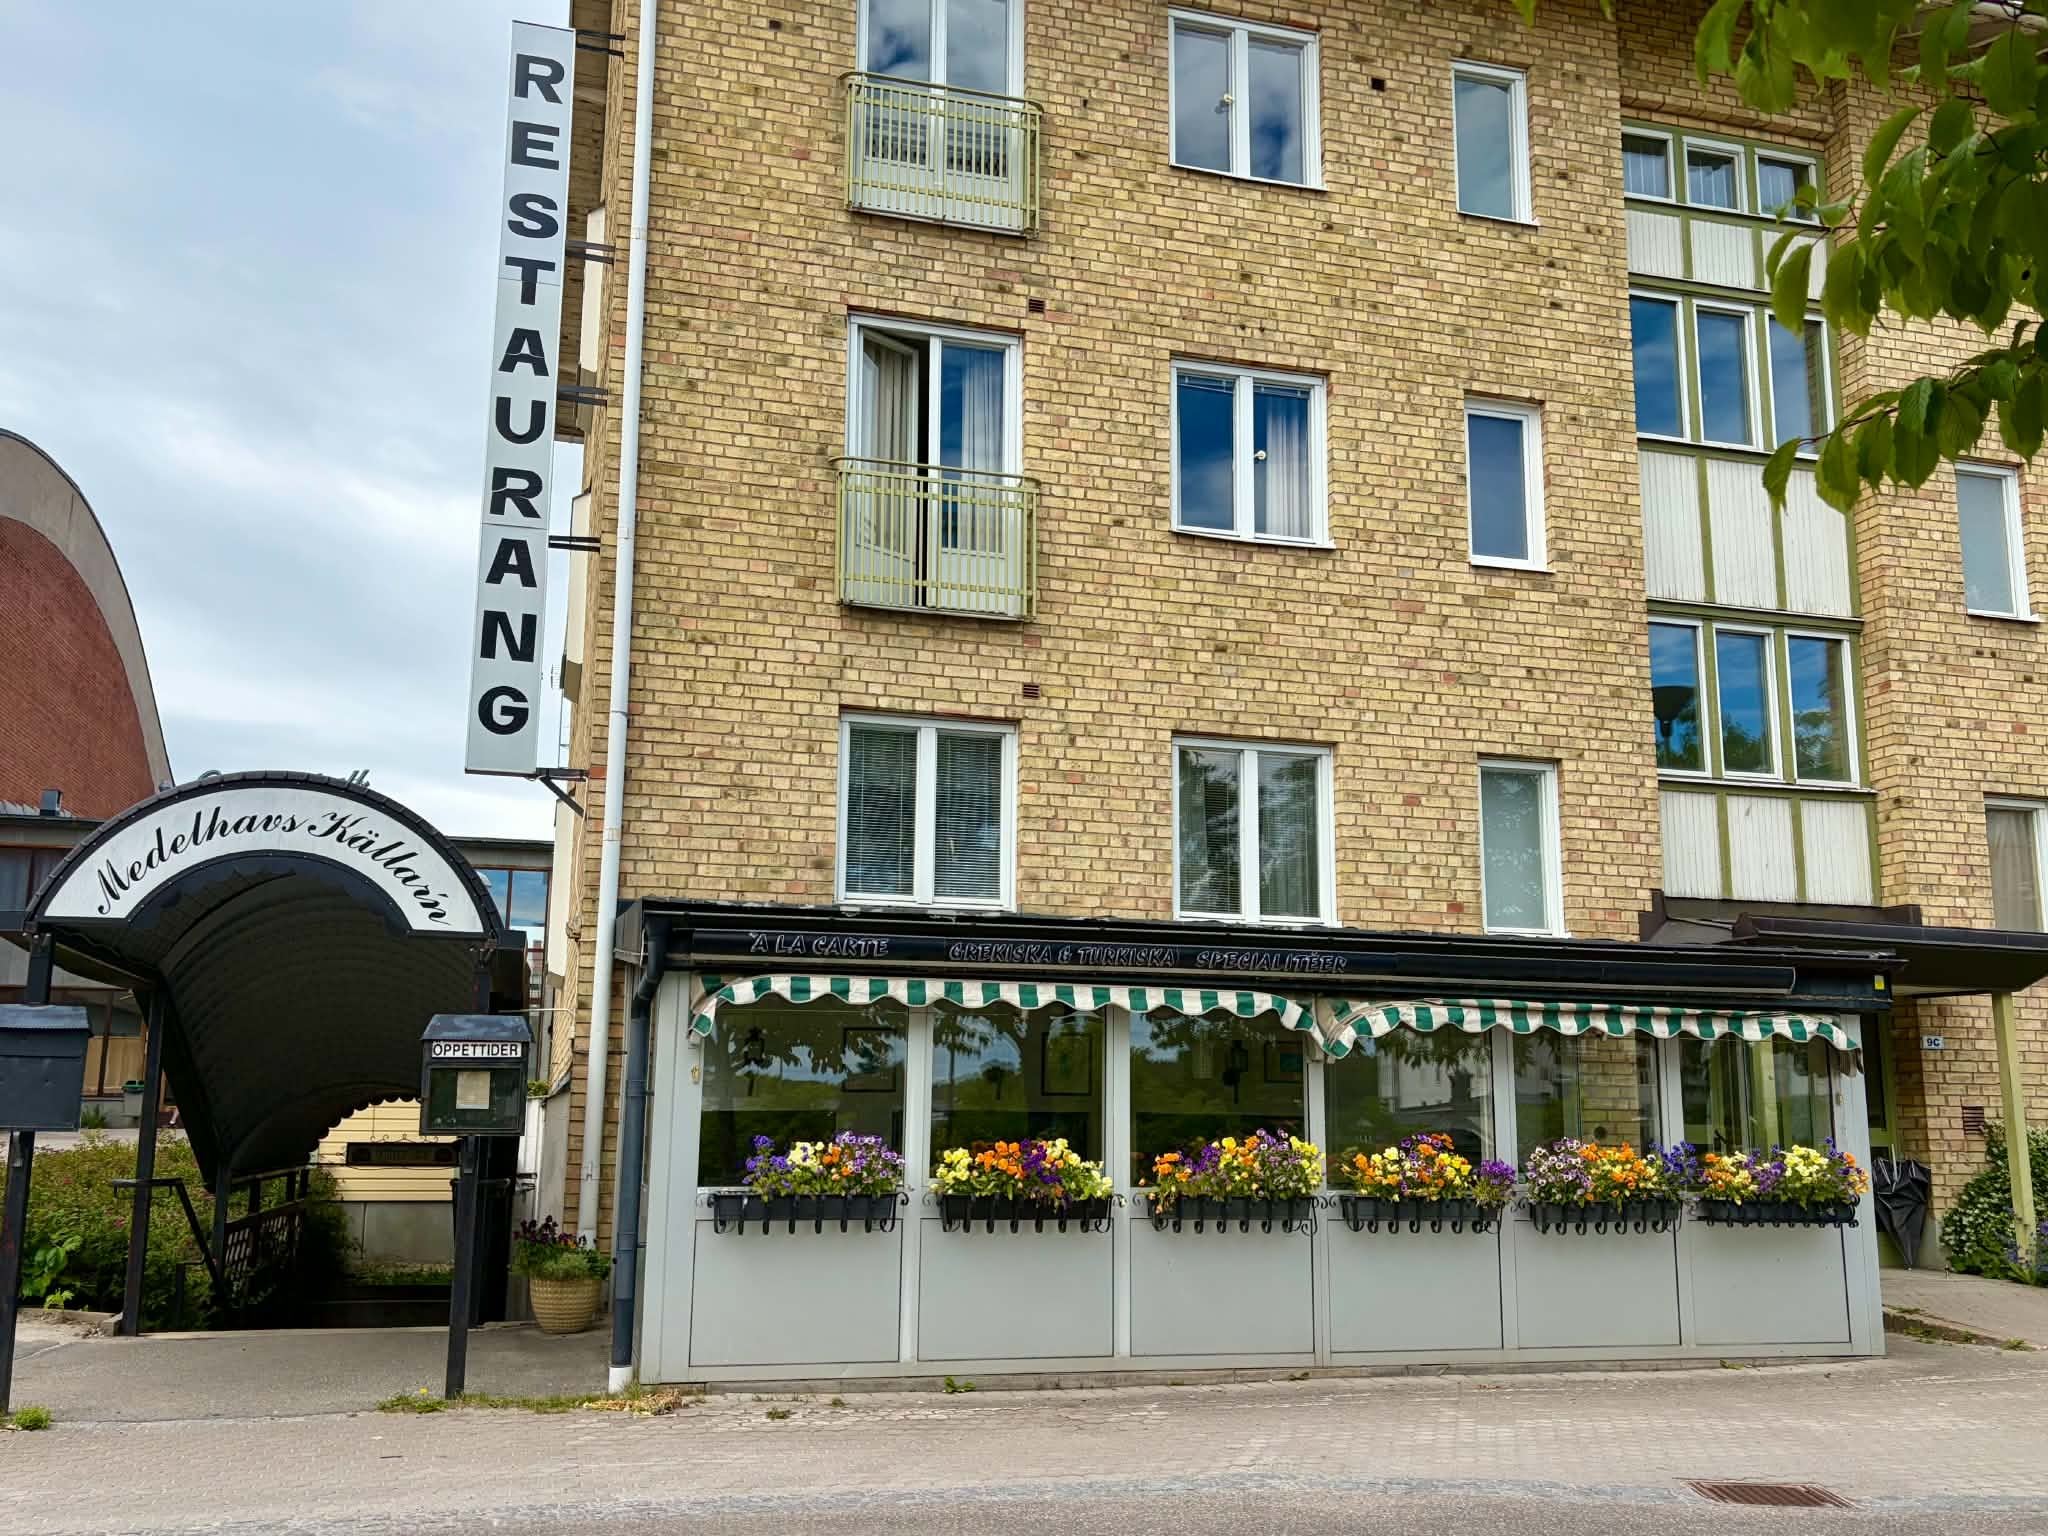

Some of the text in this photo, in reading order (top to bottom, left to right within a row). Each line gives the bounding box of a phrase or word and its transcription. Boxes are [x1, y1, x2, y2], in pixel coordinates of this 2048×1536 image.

[477, 53, 565, 736] RESTAURANG
[98, 805, 312, 915] Medelhavs
[775, 934, 807, 954] LA
[812, 935, 889, 957] CARTE
[949, 942, 1051, 963] GREKISKA
[1057, 944, 1072, 964] &
[1077, 946, 1176, 968] TURKISKA
[433, 1040, 519, 1057] ÖPPETTIDER
[1927, 1038, 1940, 1047] 9C
